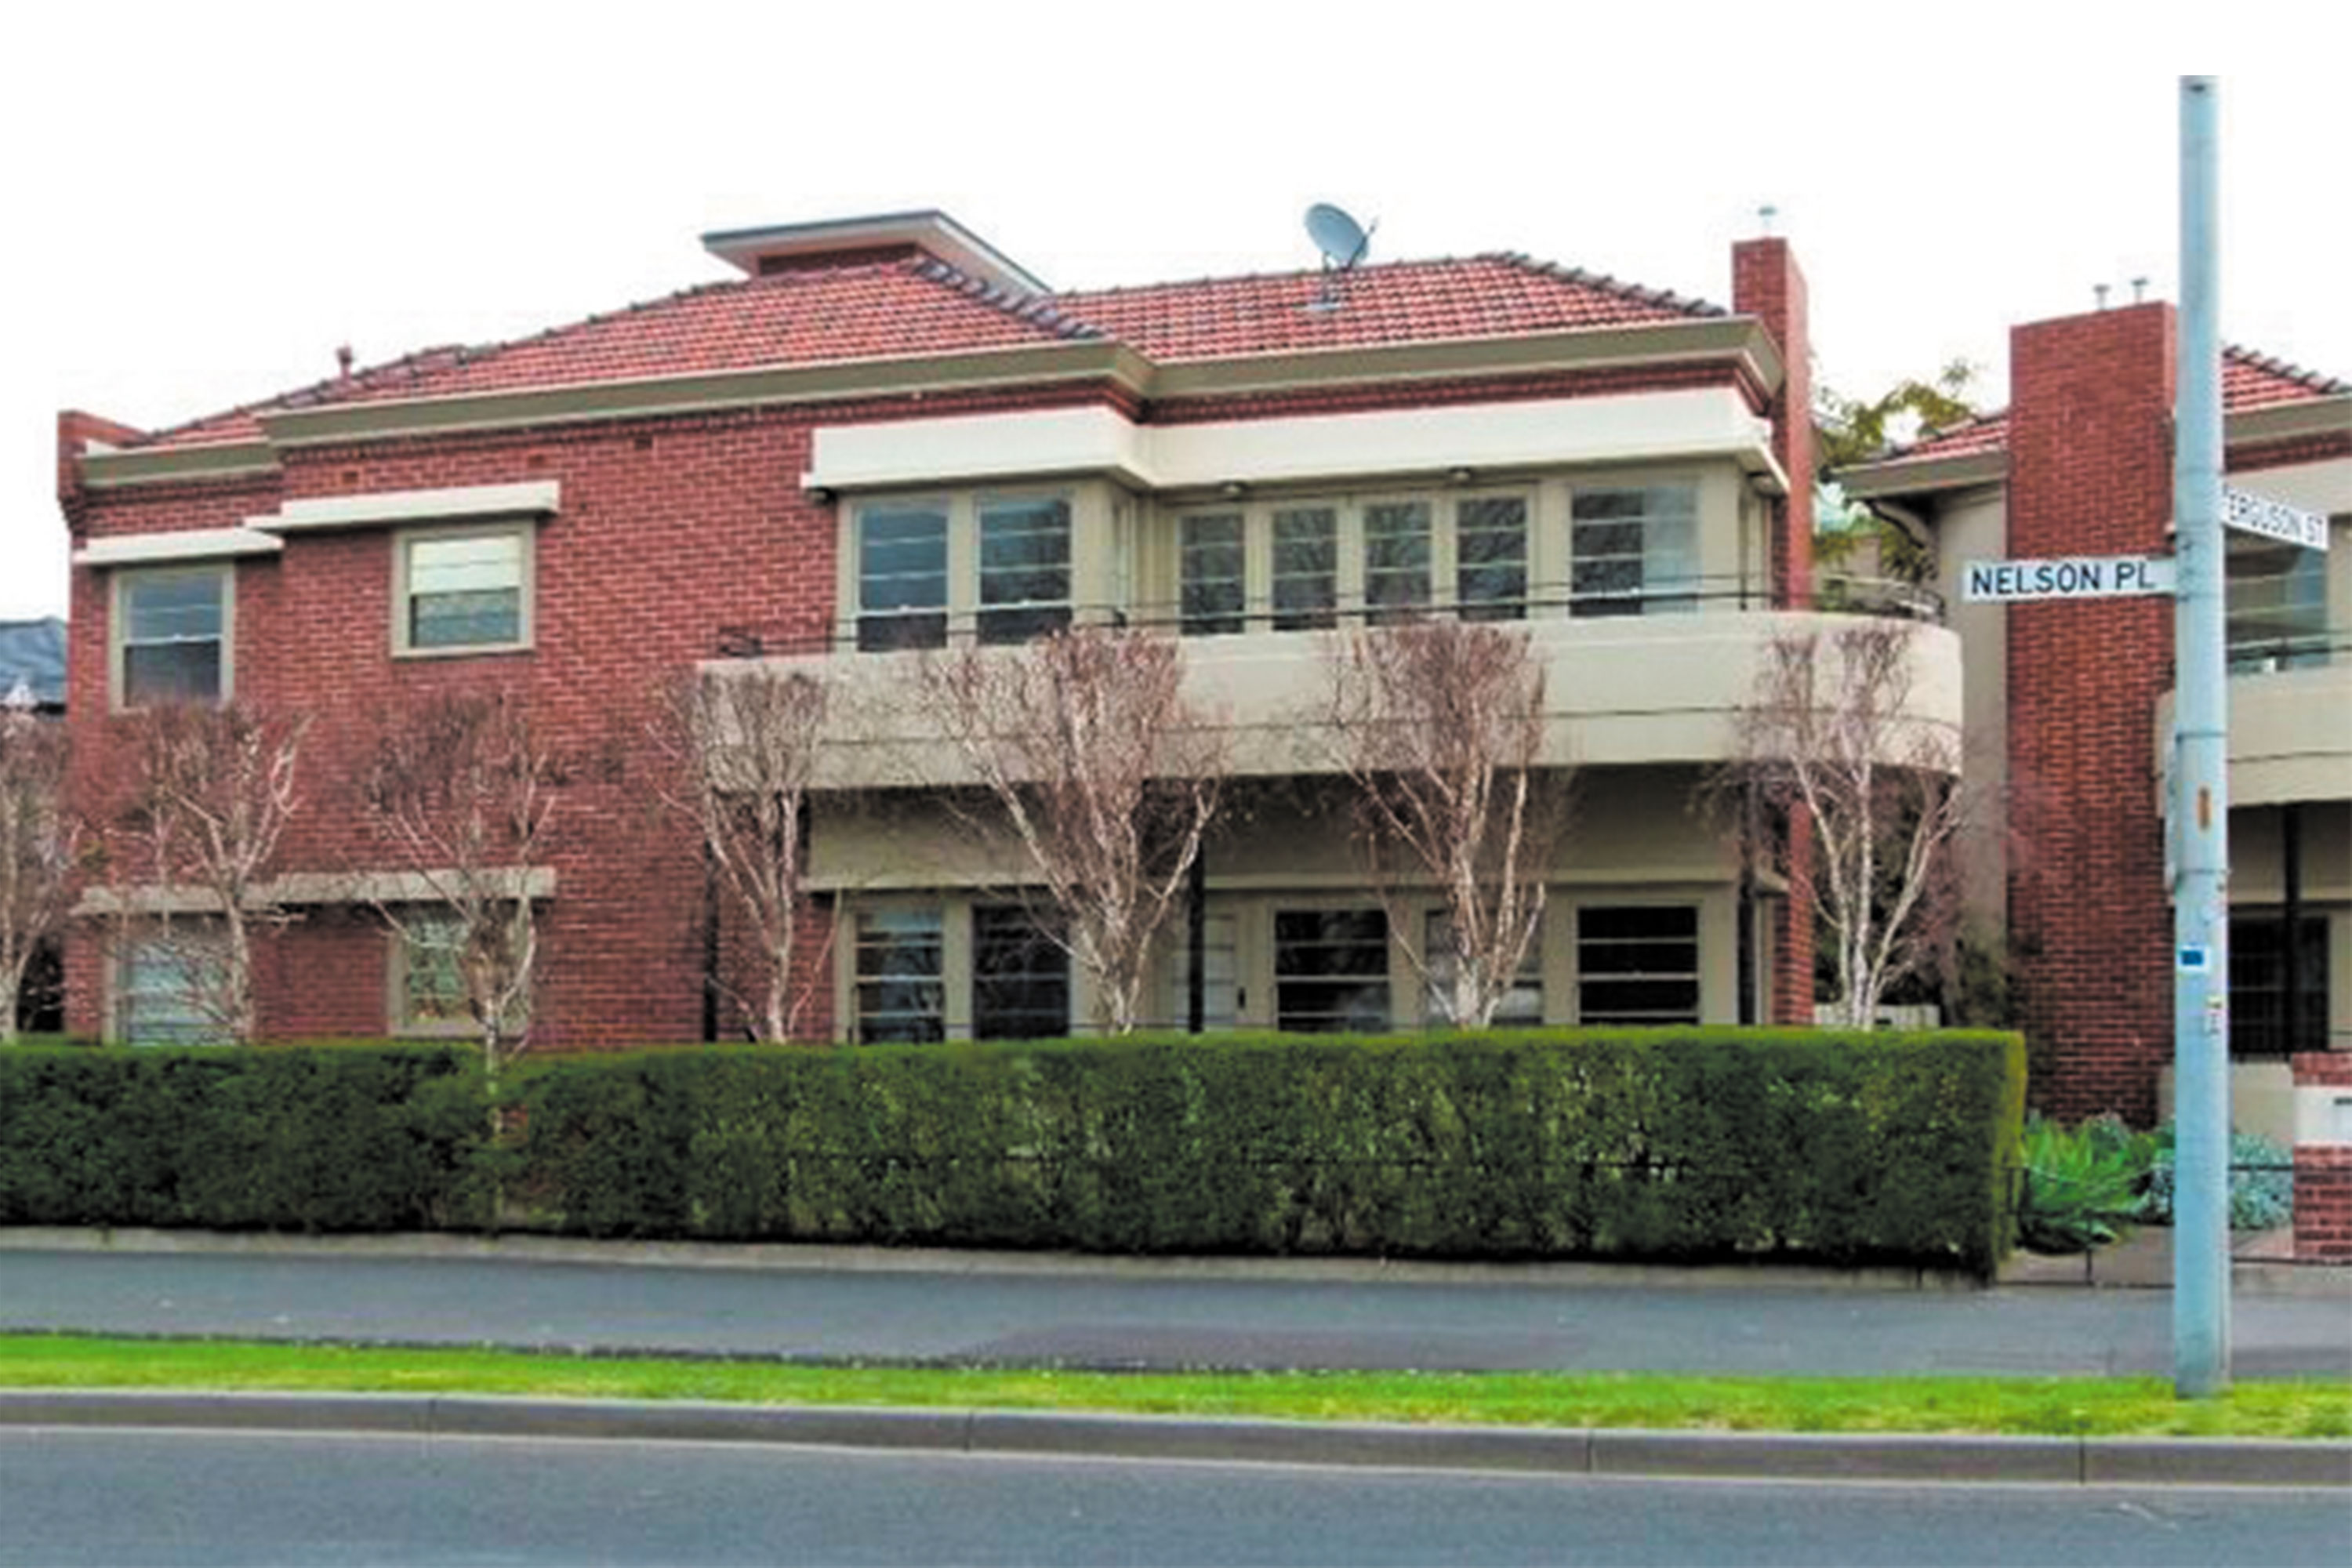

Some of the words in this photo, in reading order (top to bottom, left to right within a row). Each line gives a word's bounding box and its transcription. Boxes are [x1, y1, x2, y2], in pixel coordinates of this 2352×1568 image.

[2307, 515, 2324, 543] ST
[1971, 562, 2102, 594] NELSON
[2115, 561, 2156, 589] PL
